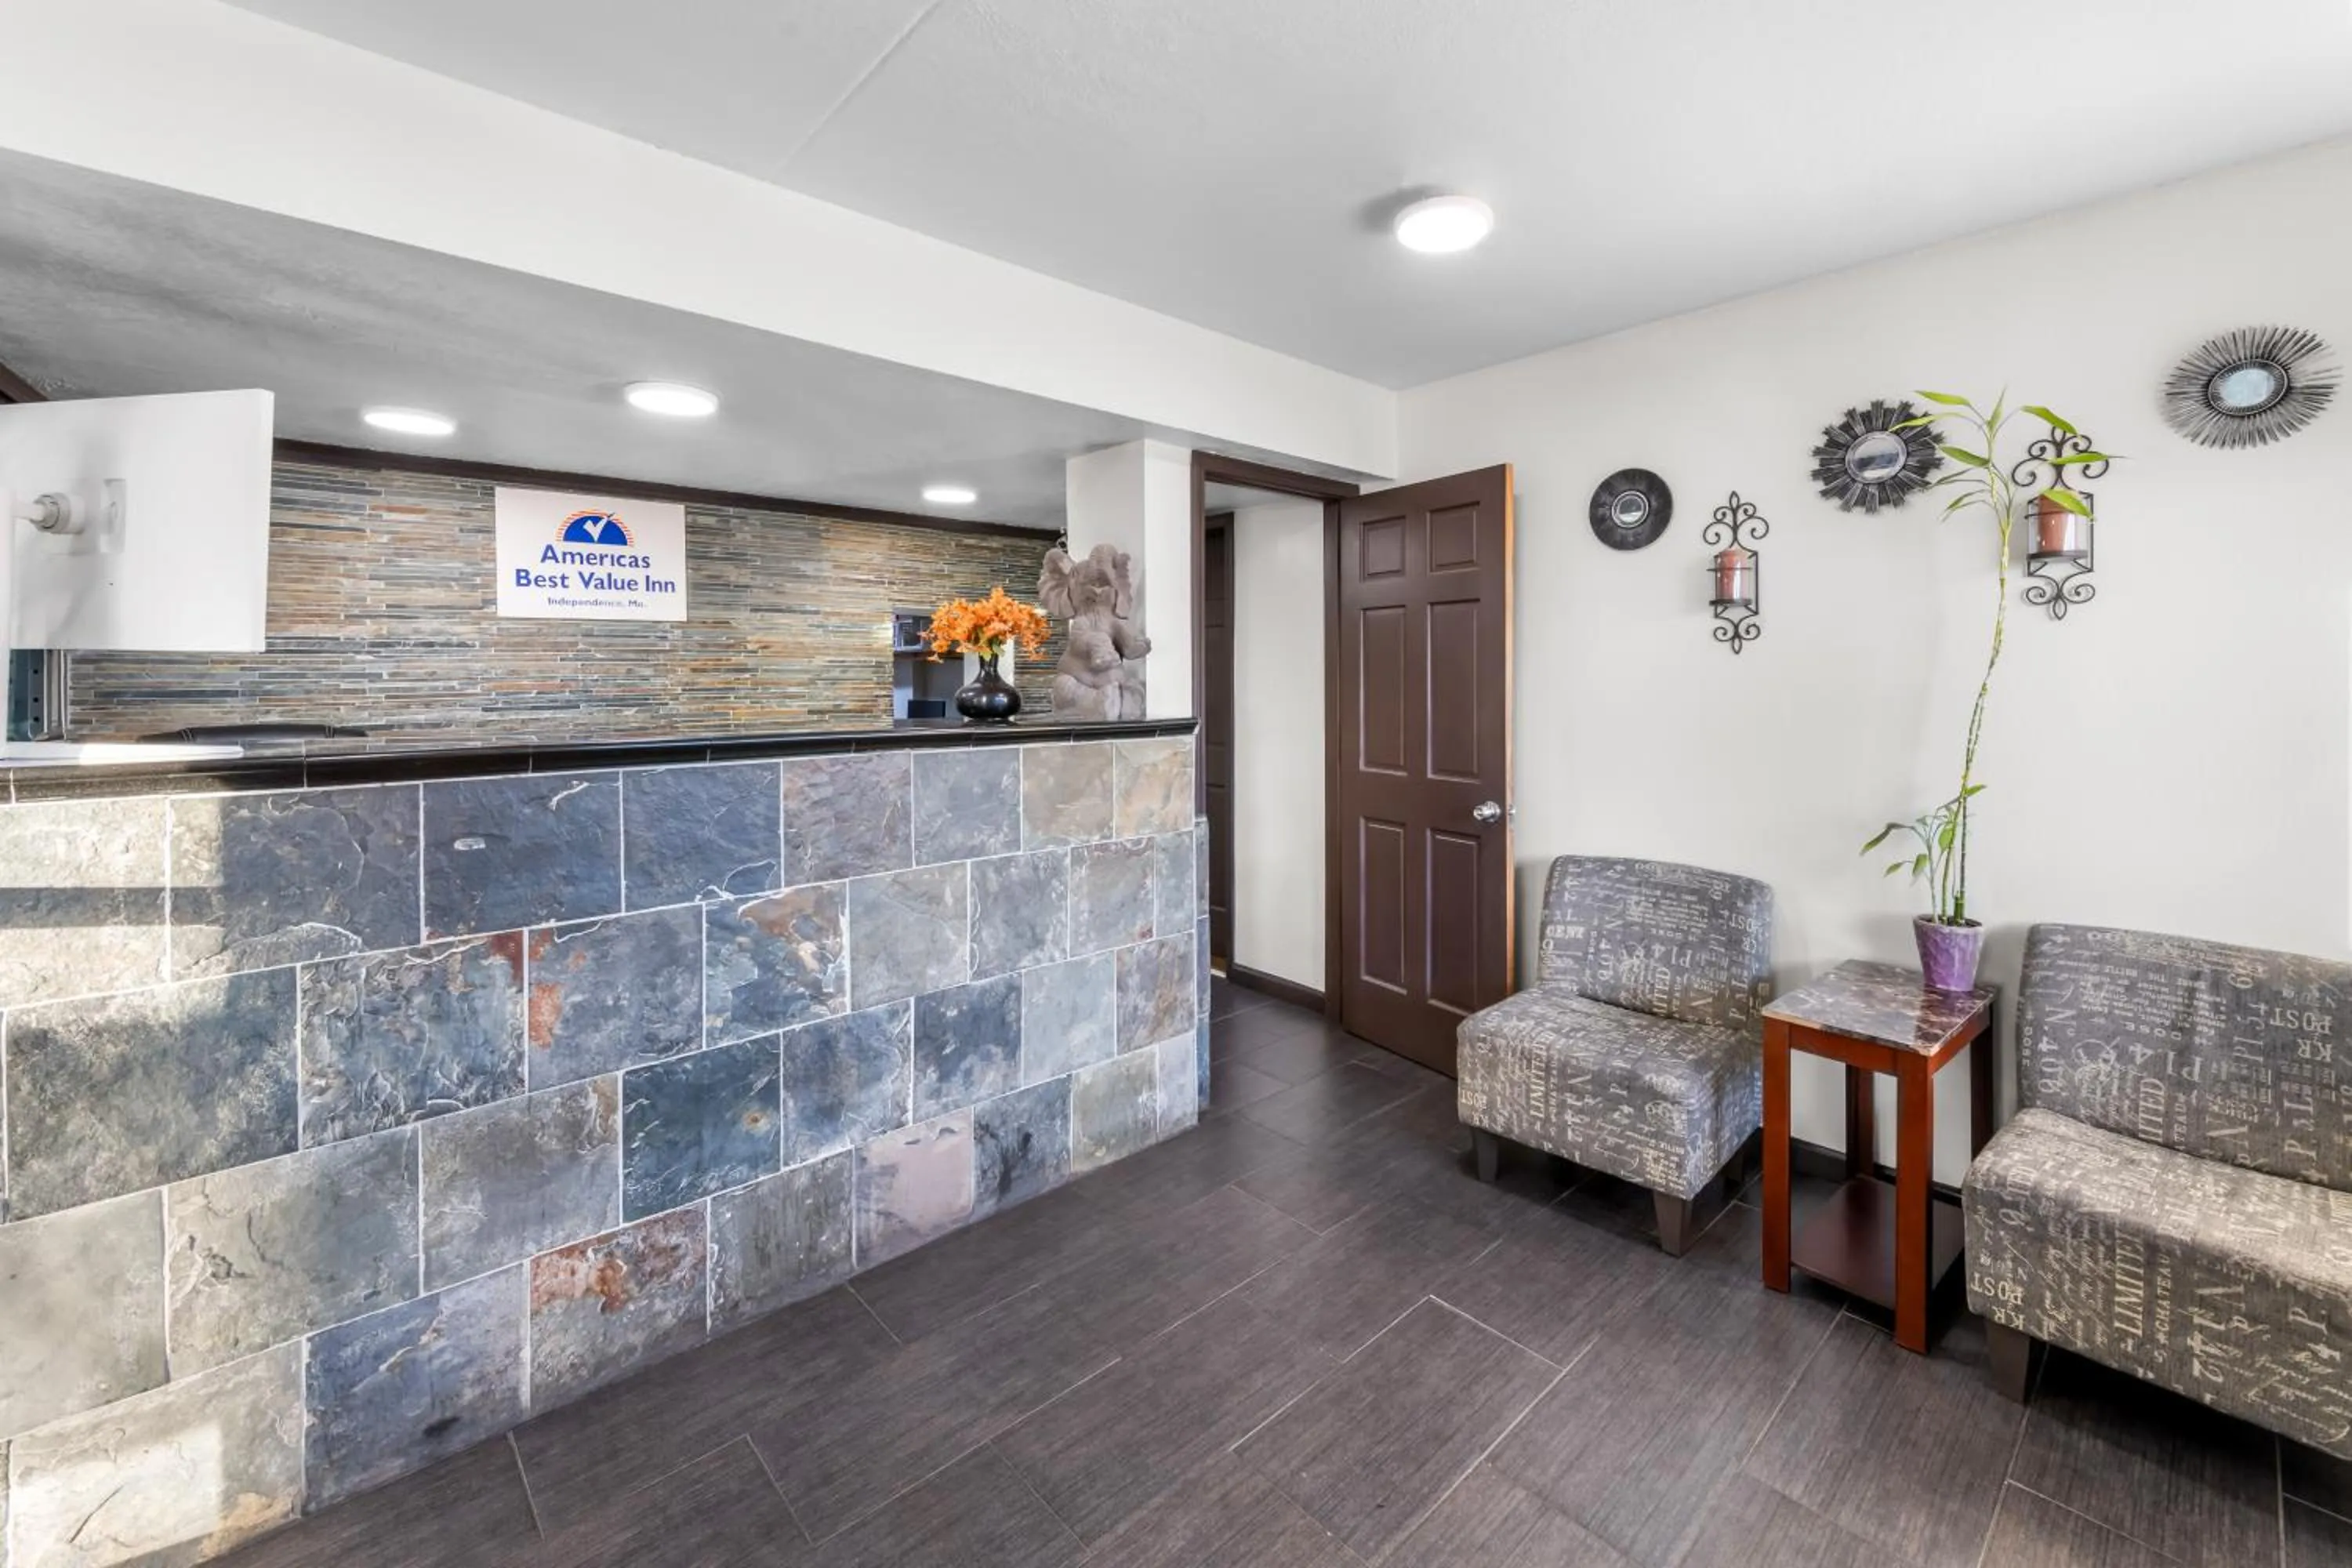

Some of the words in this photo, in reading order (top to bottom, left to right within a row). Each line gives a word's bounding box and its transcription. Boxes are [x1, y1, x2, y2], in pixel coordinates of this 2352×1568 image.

[540, 544, 651, 568] Americas
[515, 568, 569, 588] Best
[579, 572, 639, 592] Value
[645, 575, 676, 593] Inn
[2270, 1007, 2332, 1035] POST
[1969, 1271, 2025, 1306] POST
